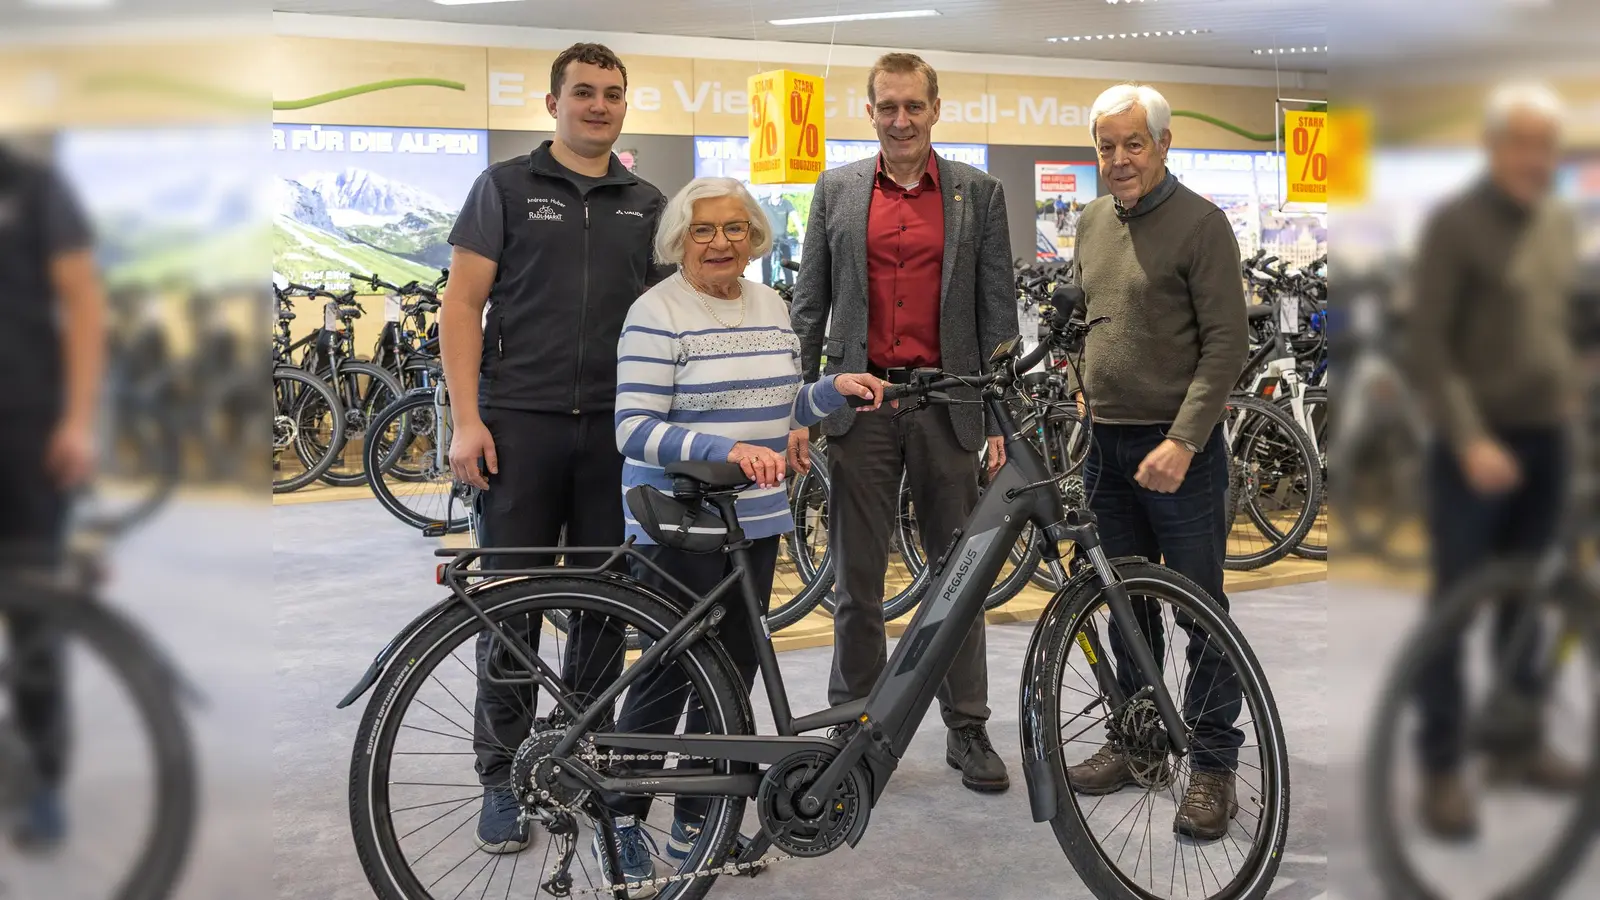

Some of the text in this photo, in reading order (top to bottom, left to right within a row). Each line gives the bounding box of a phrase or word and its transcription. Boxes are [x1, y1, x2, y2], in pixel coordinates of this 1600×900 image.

[793, 78, 815, 94] STARK
[1298, 116, 1325, 128] STARK
[291, 125, 344, 151] FÜR
[350, 131, 394, 152] DIE
[397, 132, 479, 154] ALPEN
[697, 141, 738, 159] WIR
[1292, 183, 1327, 193] REDUZIER
[550, 197, 566, 208] Huber
[943, 549, 977, 602] PEGASUS
